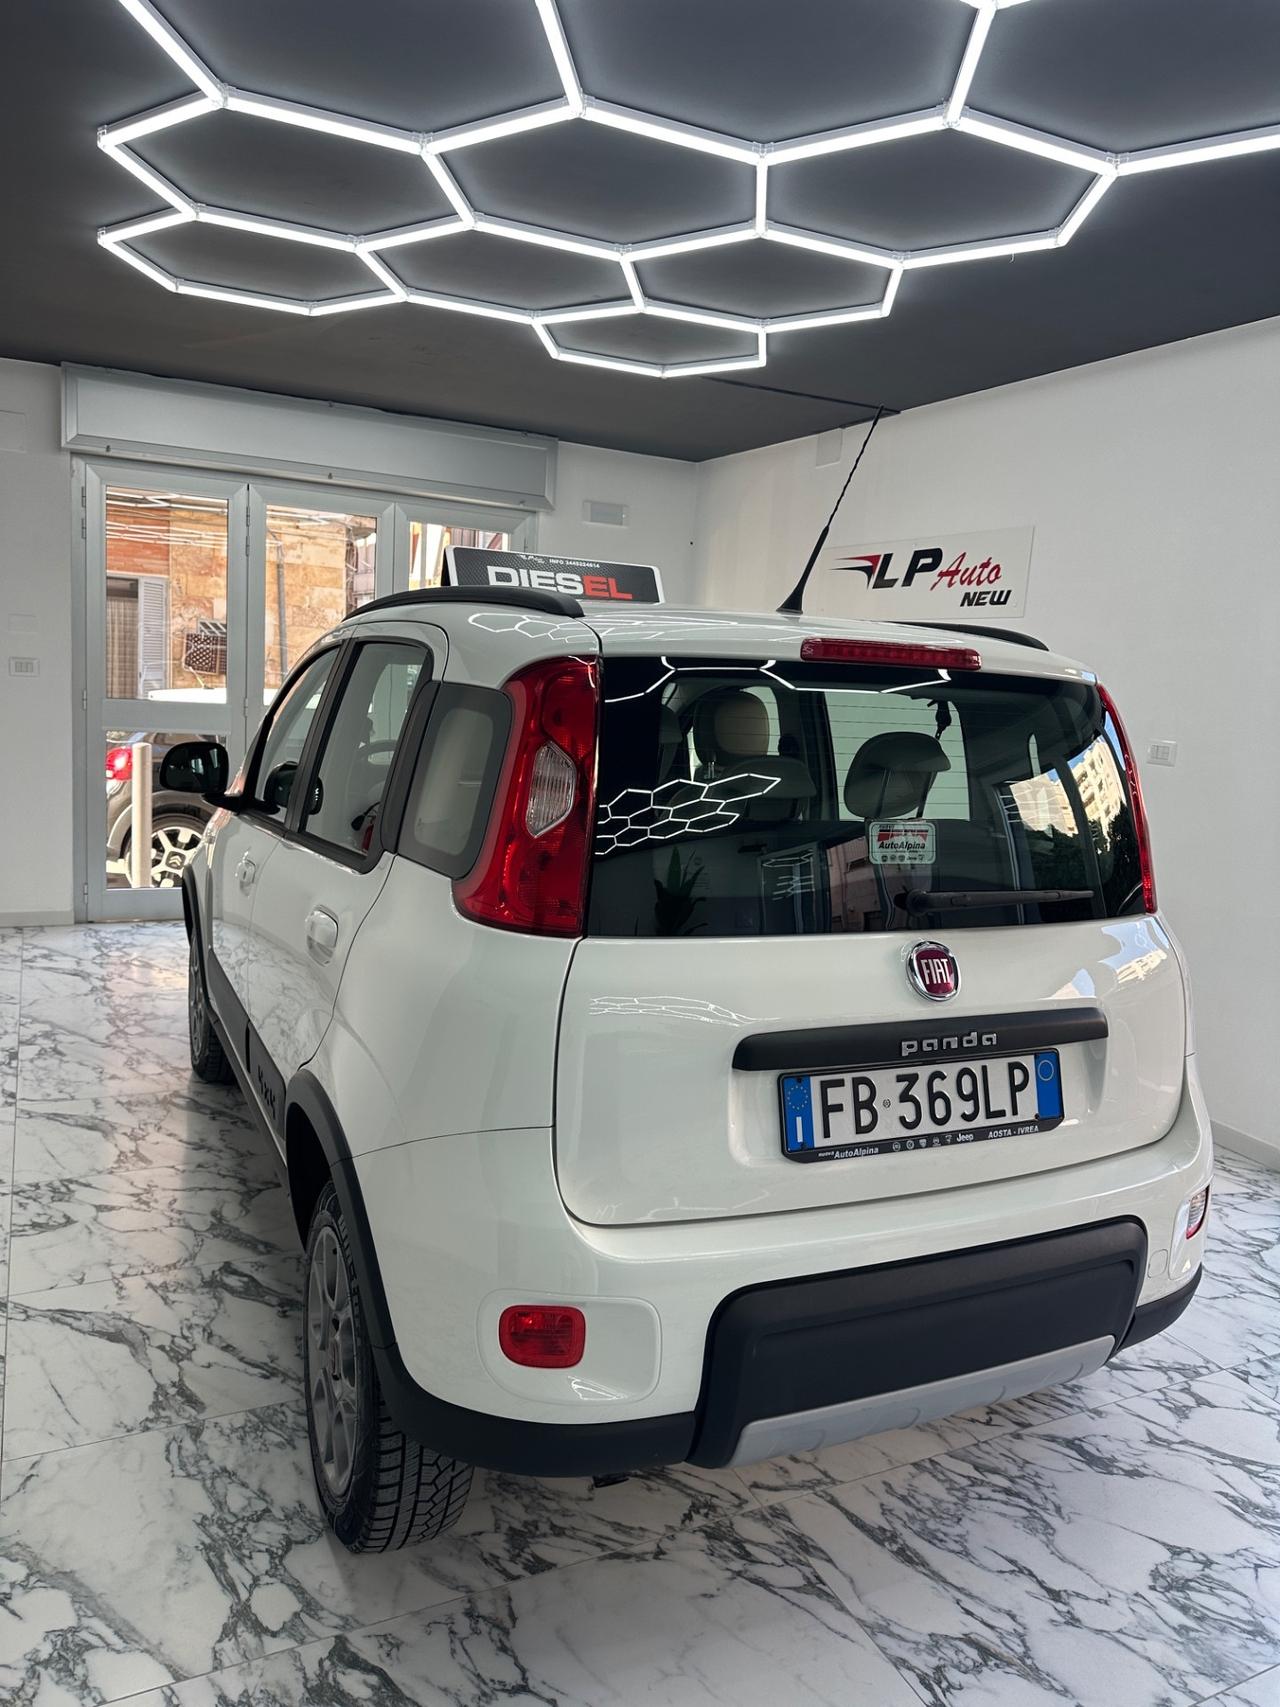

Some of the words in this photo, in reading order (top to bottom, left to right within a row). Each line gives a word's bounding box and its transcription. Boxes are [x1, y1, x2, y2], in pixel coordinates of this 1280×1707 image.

[872, 548, 943, 589] LP
[930, 552, 1002, 591] Auto
[487, 565, 633, 600] DIESEL
[960, 590, 1012, 607] NEW
[878, 841, 926, 850] AutoAlpina
[920, 958, 951, 984] FIAT
[901, 1031, 997, 1057] panda
[820, 1076, 879, 1139] FB
[896, 1061, 1030, 1130] 369LP
[956, 1132, 974, 1143] Jeep
[988, 1128, 1012, 1139] AOSTA
[1017, 1125, 1039, 1135] IVREA
[834, 1146, 879, 1159] AutoAlpina
